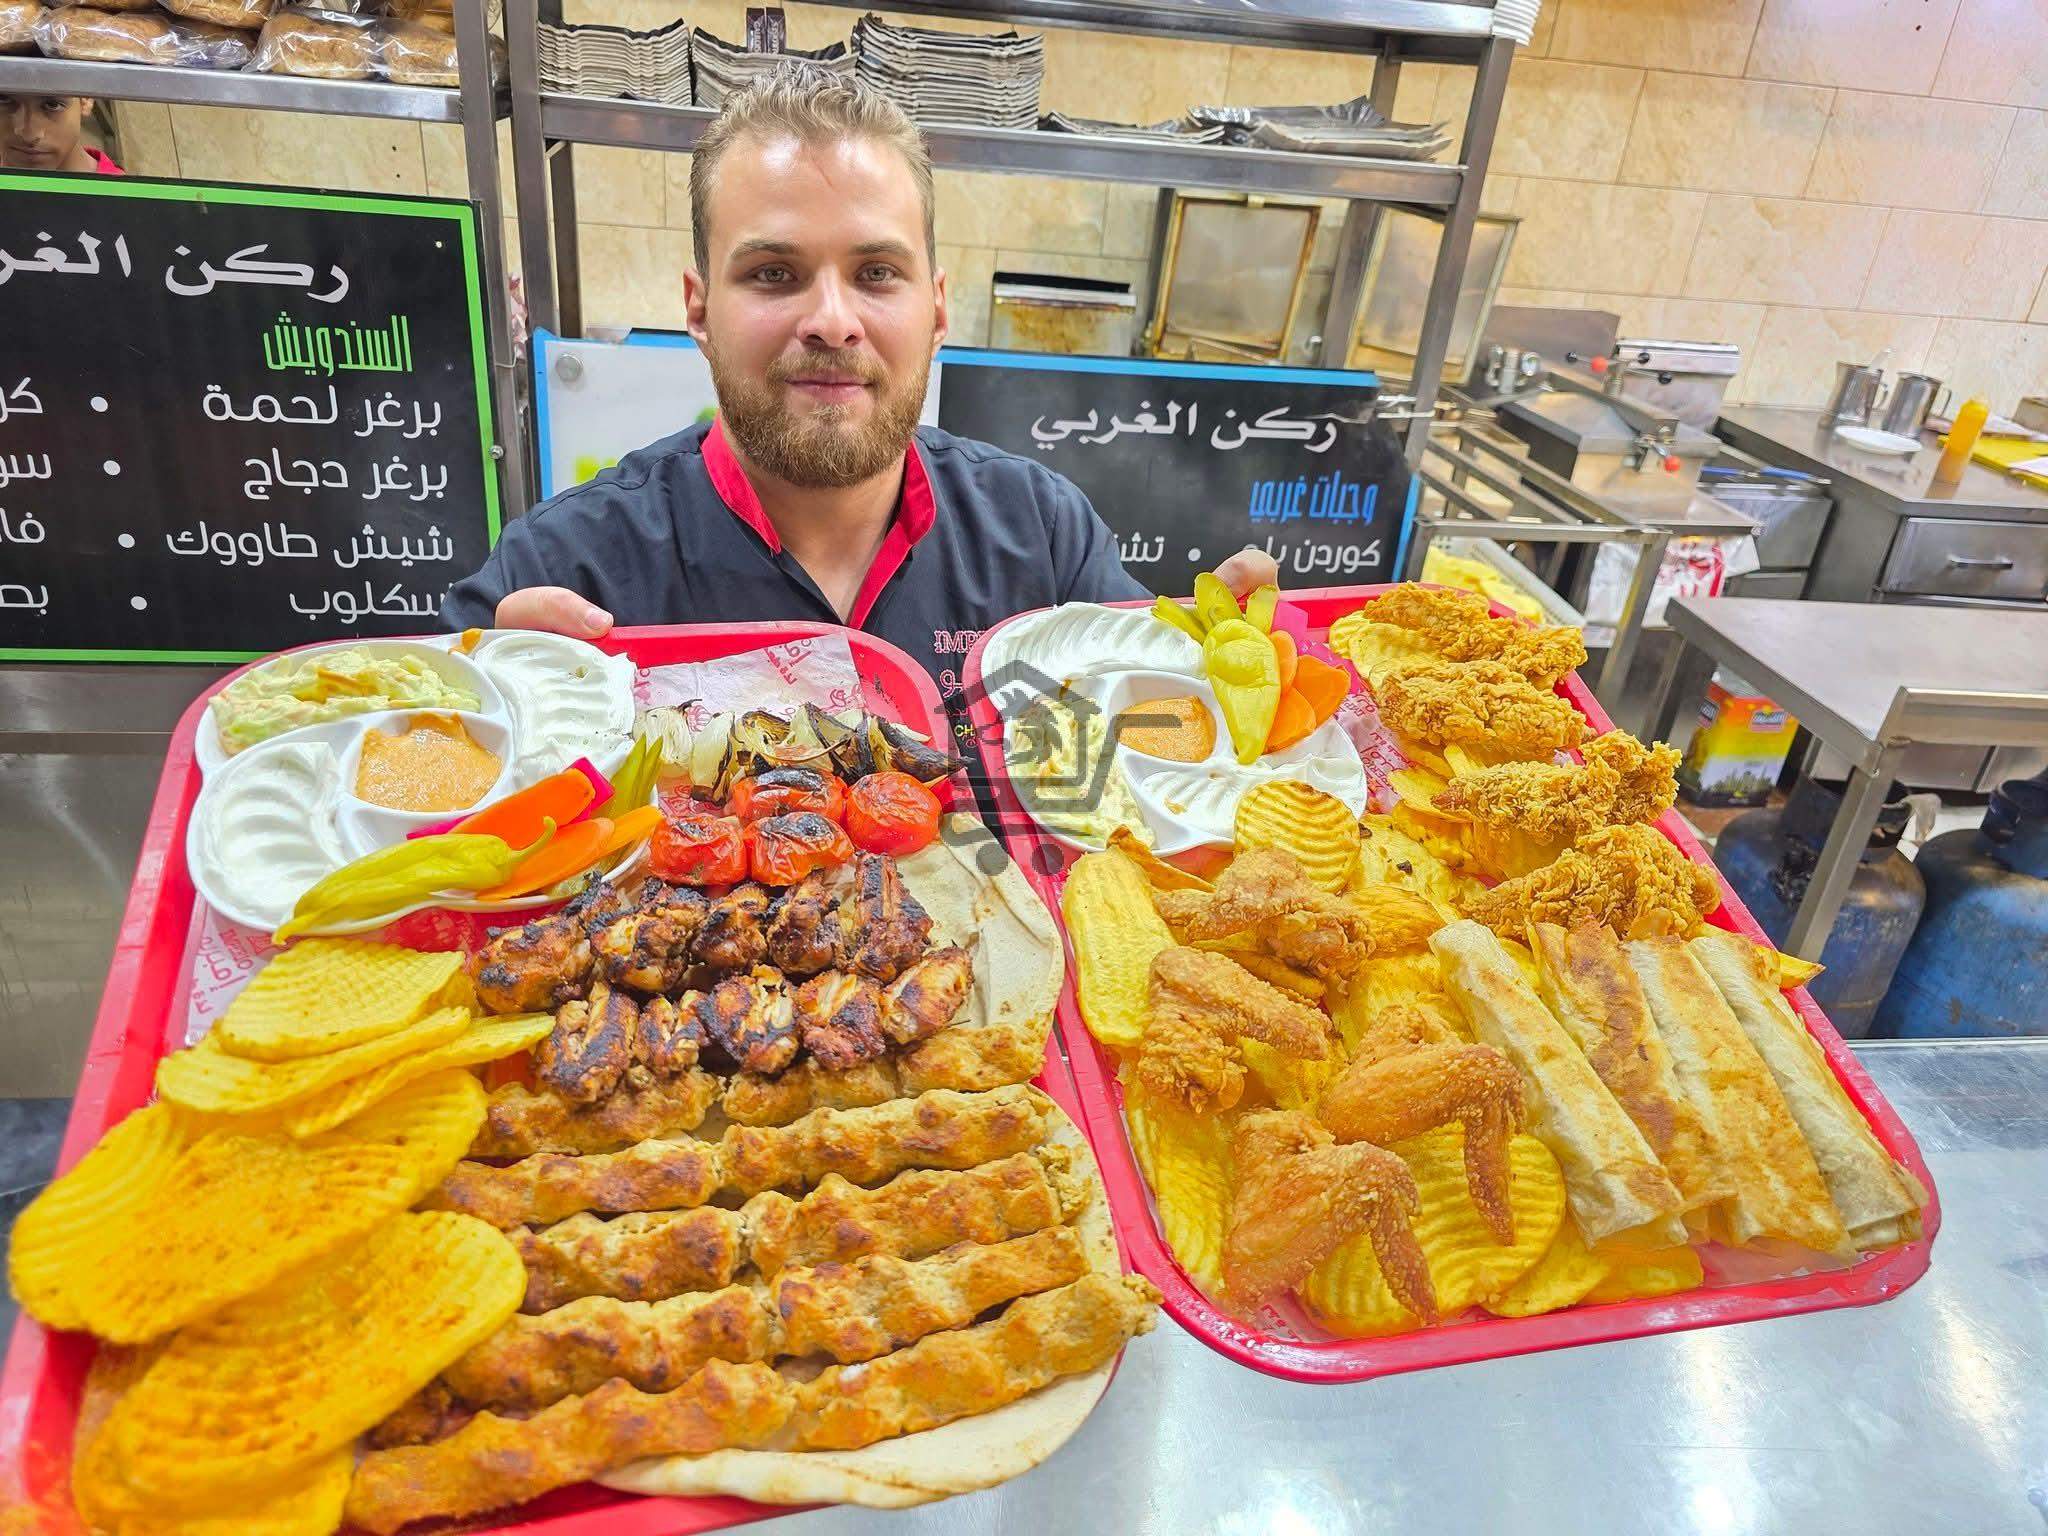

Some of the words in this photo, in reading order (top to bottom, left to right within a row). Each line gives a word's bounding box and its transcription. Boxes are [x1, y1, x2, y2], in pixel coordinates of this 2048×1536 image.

[165, 243, 349, 303] ركن
[263, 311, 412, 377] السندويش
[203, 384, 338, 424] لحمة
[354, 391, 442, 438] برغر
[1031, 400, 1197, 450] الغربي
[1210, 405, 1337, 453] ركن
[244, 447, 348, 500] دجاج
[362, 455, 448, 501] برغر
[1248, 475, 1307, 526] غربي
[1309, 470, 1379, 526] وجبات
[166, 521, 318, 566] طاووك
[333, 524, 453, 568] شيش
[1293, 539, 1380, 574] كوردن
